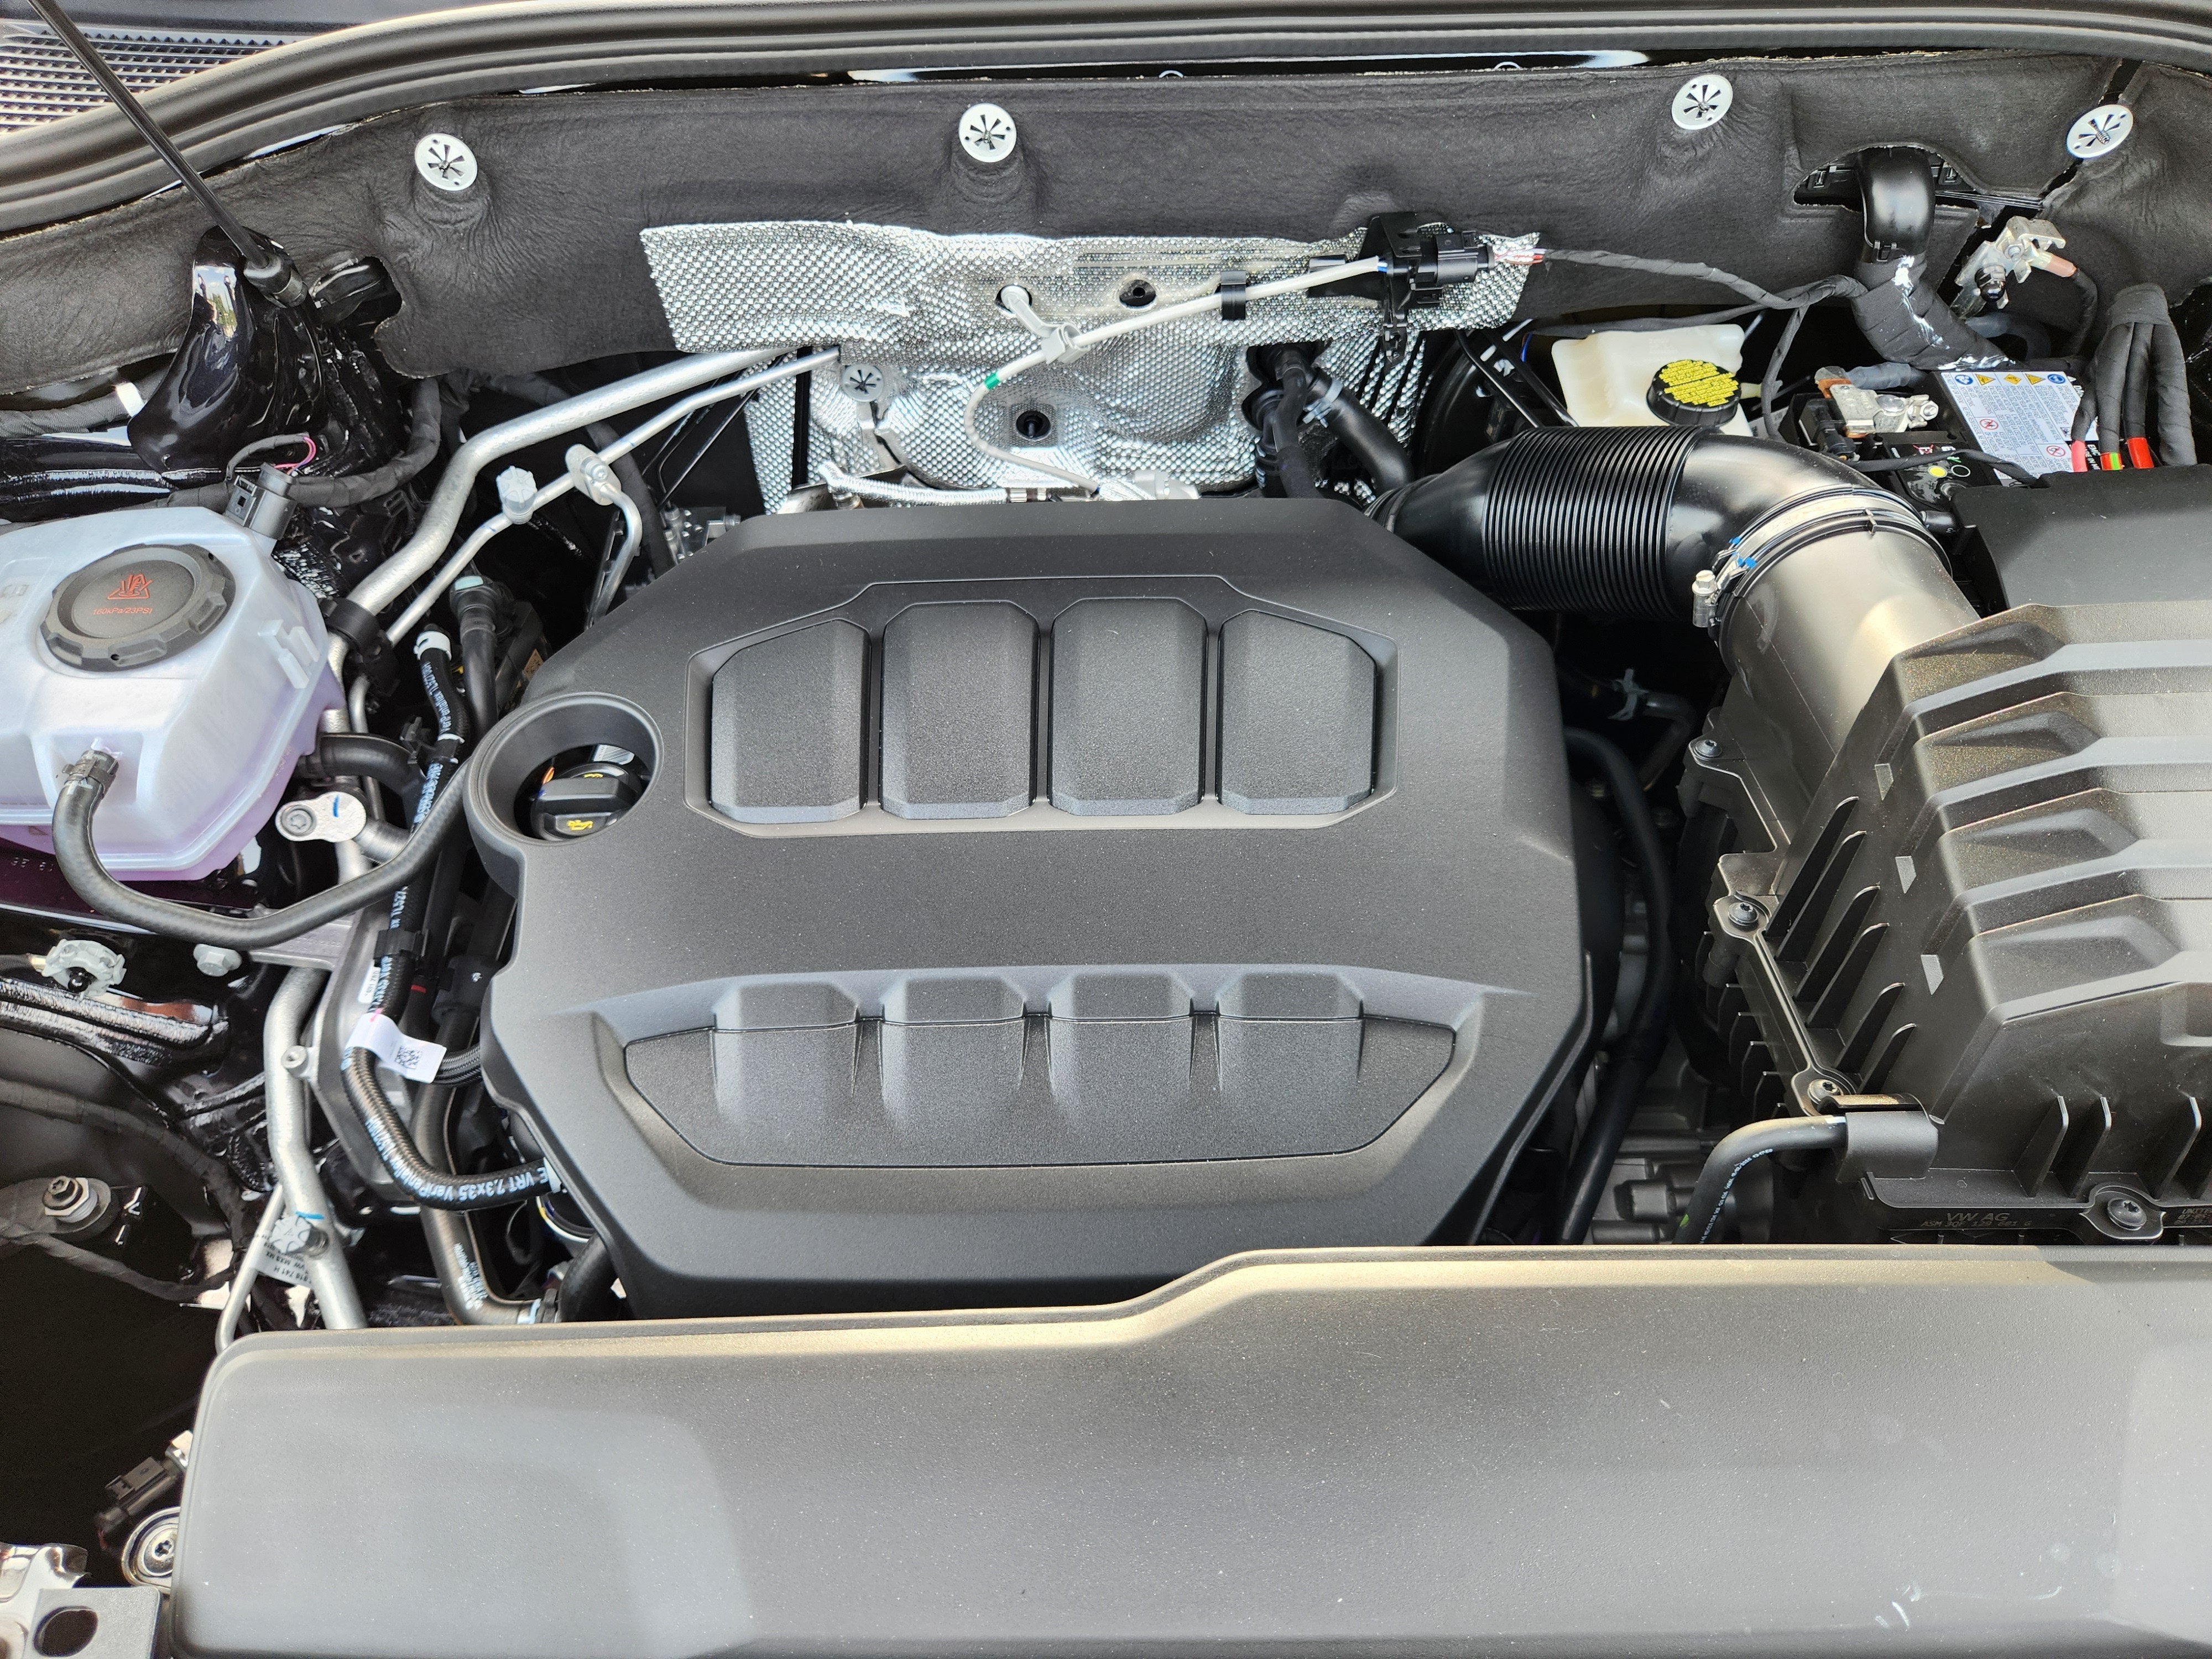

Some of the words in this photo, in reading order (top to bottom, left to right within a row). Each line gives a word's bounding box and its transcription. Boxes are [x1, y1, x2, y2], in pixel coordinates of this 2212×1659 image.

[92, 607, 153, 615] 160kPa/23PSI
[508, 1171, 535, 1193] VRT
[1947, 1213, 1979, 1222] VW
[1981, 1213, 2010, 1222] AG
